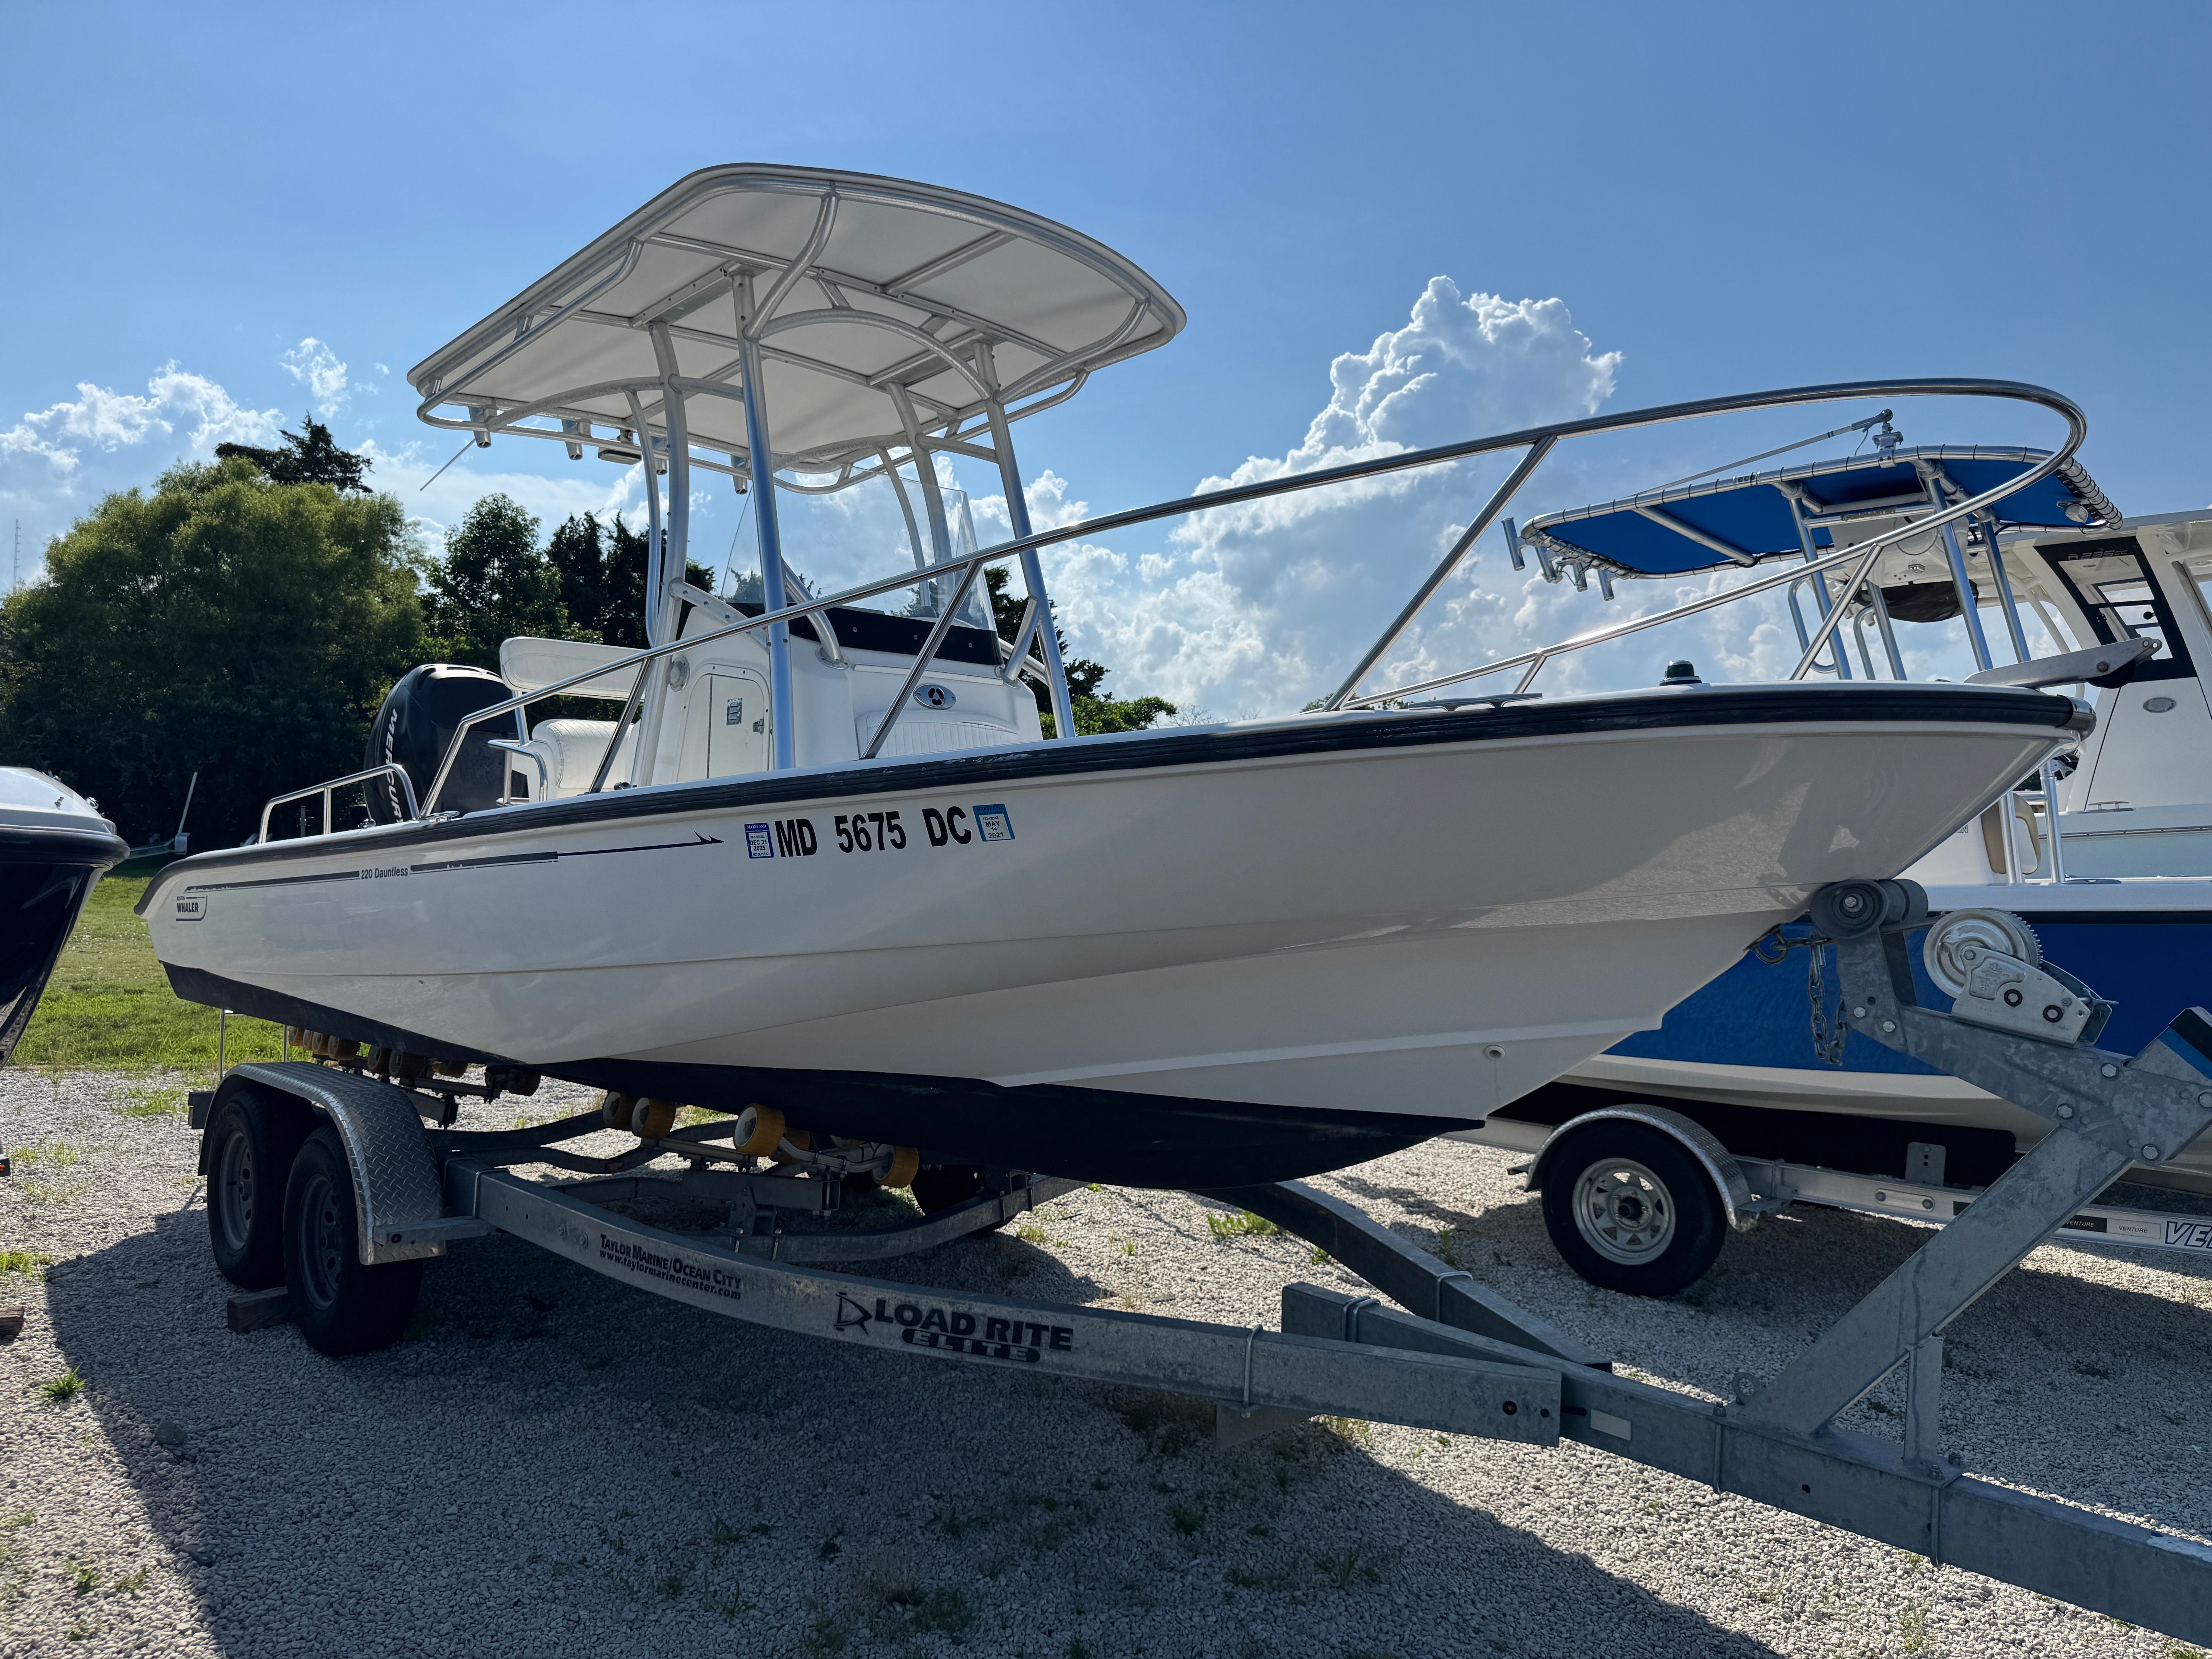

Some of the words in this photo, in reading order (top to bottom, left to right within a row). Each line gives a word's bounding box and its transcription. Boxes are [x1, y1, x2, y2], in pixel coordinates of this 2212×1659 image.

[775, 818, 817, 857] MD
[835, 811, 907, 853] 5675
[922, 806, 972, 847] DC
[361, 869, 372, 879] 220
[374, 866, 408, 878] Dauntless
[177, 902, 199, 913] WHALER
[2165, 1221, 2212, 1249] VE
[599, 1250, 741, 1300] www.taylormarinecenter.com
[600, 1233, 631, 1257] TAYLOR
[713, 1269, 742, 1289] CITY
[874, 1298, 976, 1335] LOAD
[986, 1317, 1073, 1352] RITE
[912, 1332, 1029, 1361] ELITE
